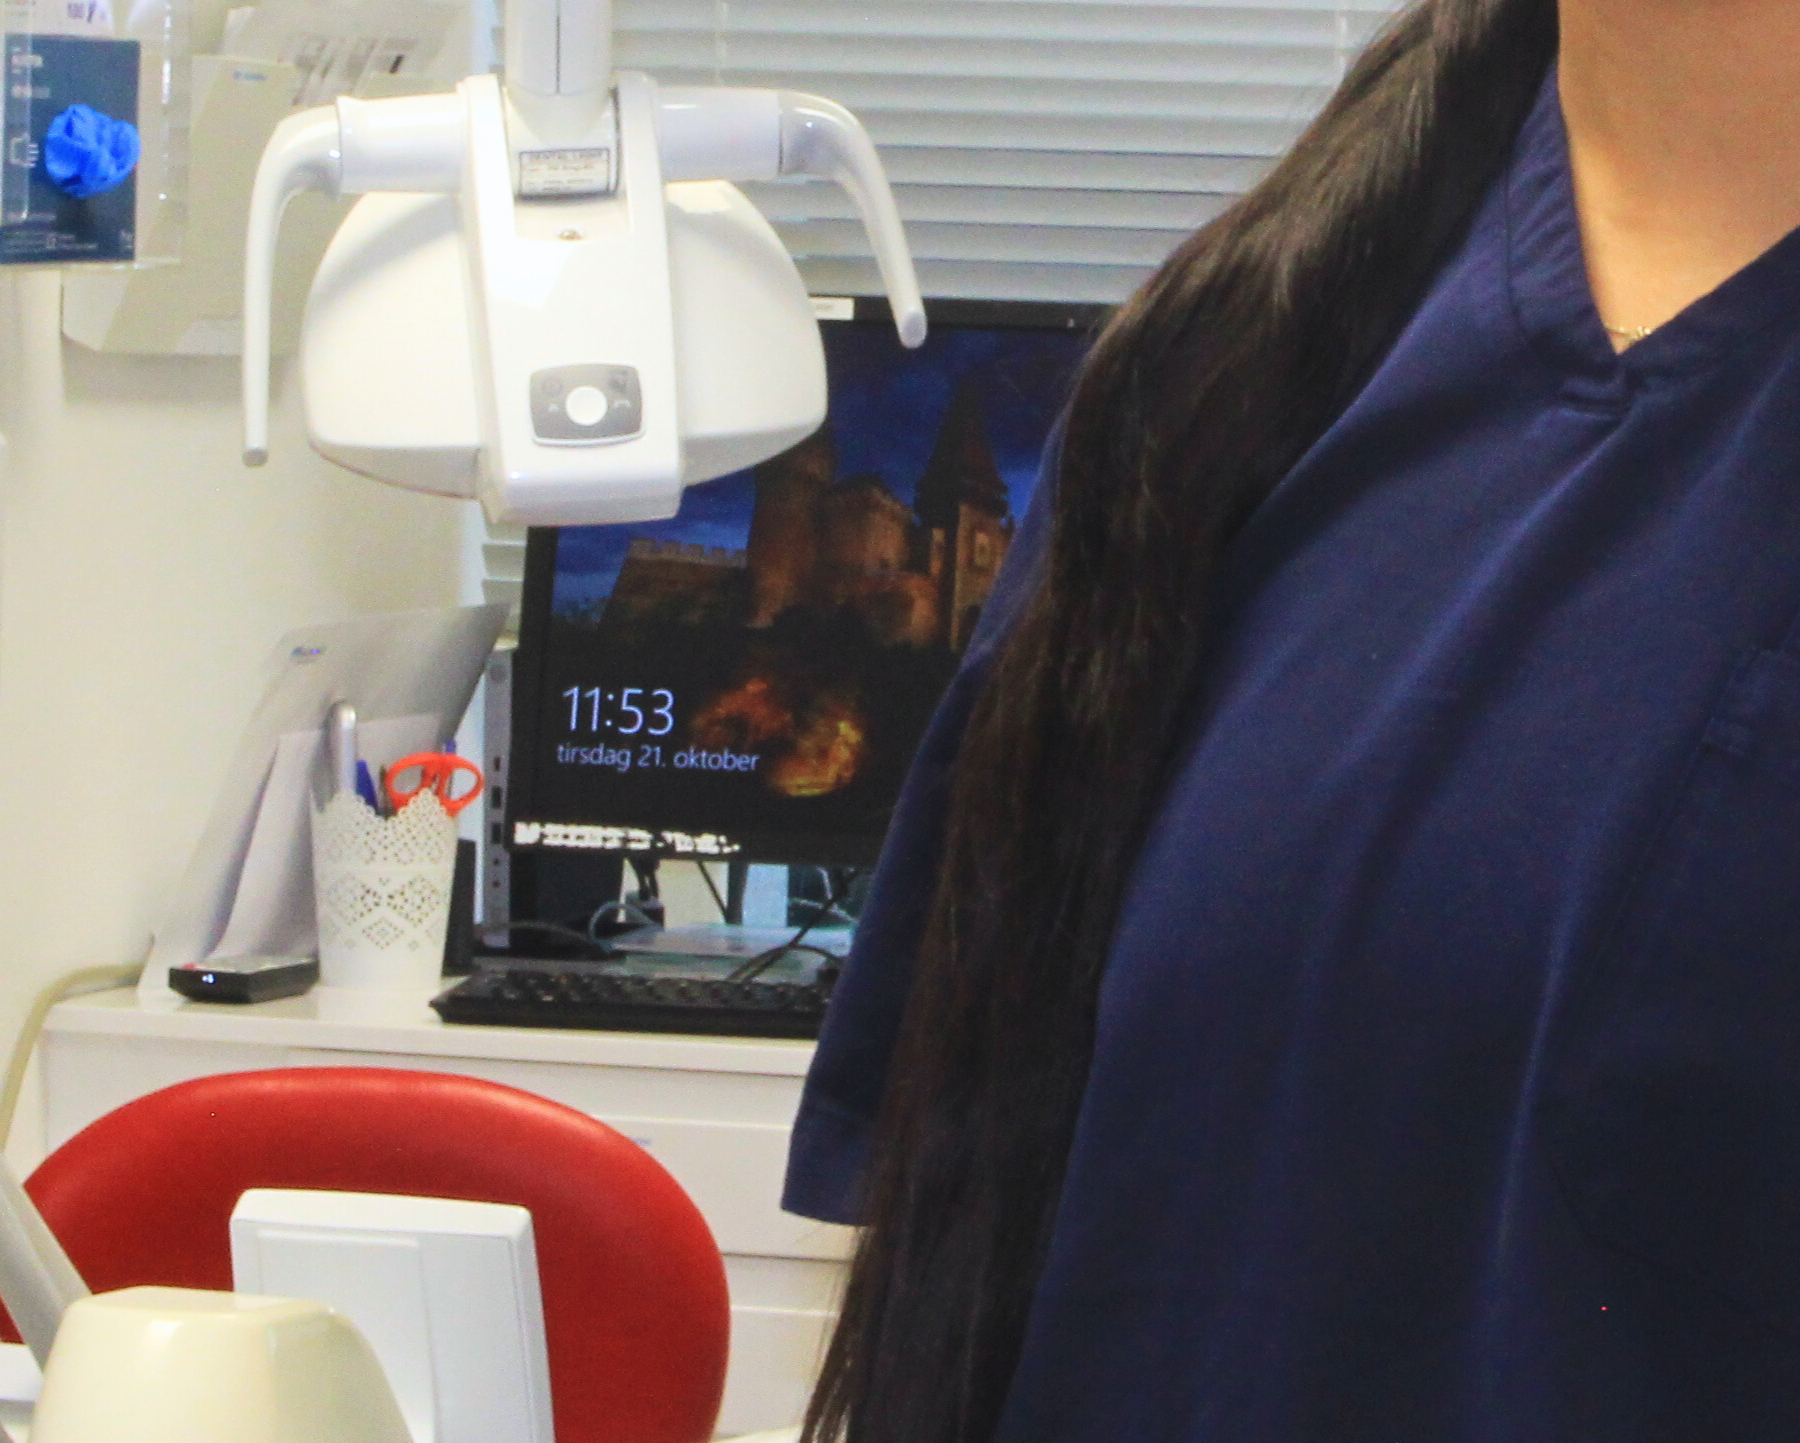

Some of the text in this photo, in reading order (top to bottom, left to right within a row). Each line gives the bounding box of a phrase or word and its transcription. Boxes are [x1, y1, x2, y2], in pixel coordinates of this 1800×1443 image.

[562, 686, 674, 736] 11:53
[556, 743, 760, 772] tirsdag 21. oktober
